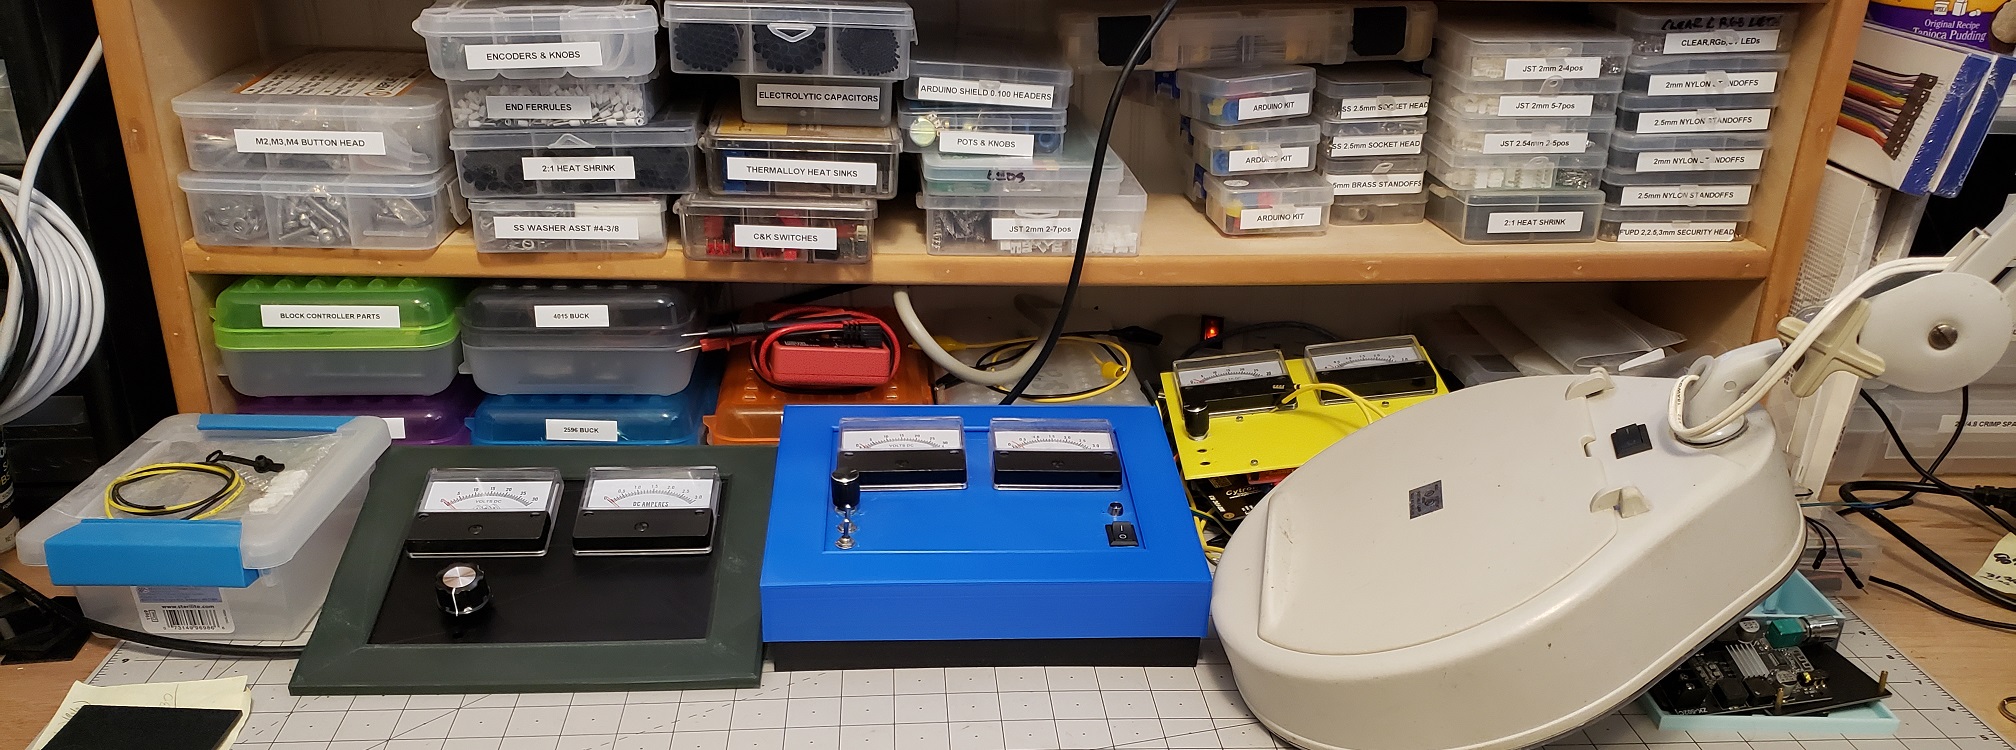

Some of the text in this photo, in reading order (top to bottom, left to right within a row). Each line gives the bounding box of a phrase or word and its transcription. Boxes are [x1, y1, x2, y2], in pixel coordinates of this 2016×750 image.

[1924, 19, 1980, 30] Original Recipe
[1740, 37, 1760, 45] LEDs
[1949, 30, 1987, 42] Pudding
[486, 50, 581, 61] ENCODERS & KNOBS
[1558, 64, 1584, 74] 2-4pos
[1712, 80, 1759, 88] NDOFFS
[758, 91, 879, 102] ELECTROLYTIC CAPACITORS
[920, 85, 1052, 101] ARDUINO SHIELD 0.100 HEADERS
[505, 102, 572, 112] END FERRULES
[1253, 101, 1295, 112] ARDUINO KIT
[1408, 102, 1429, 110] HEAD
[1550, 102, 1576, 110] 5-7pos
[255, 137, 366, 148] M2,M3,M4 BUTTON HEAD
[956, 138, 978, 146] POTS
[988, 140, 1016, 148] KNOBS
[1368, 141, 1398, 149] SOCKET
[1246, 156, 1278, 164] ARDU
[542, 164, 616, 173] 2:1 HEAT SHRINK
[746, 166, 858, 178] THERMALLOY HEAT SINKS
[1351, 180, 1377, 188] BRASS
[1378, 180, 1422, 188] STANDOFFS
[1256, 213, 1291, 222] ARDUINO
[513, 224, 619, 233] SS WASHER ASST #4-3/8
[1046, 226, 1072, 235] 2-7pos
[753, 232, 818, 242] C&K SWITCHES
